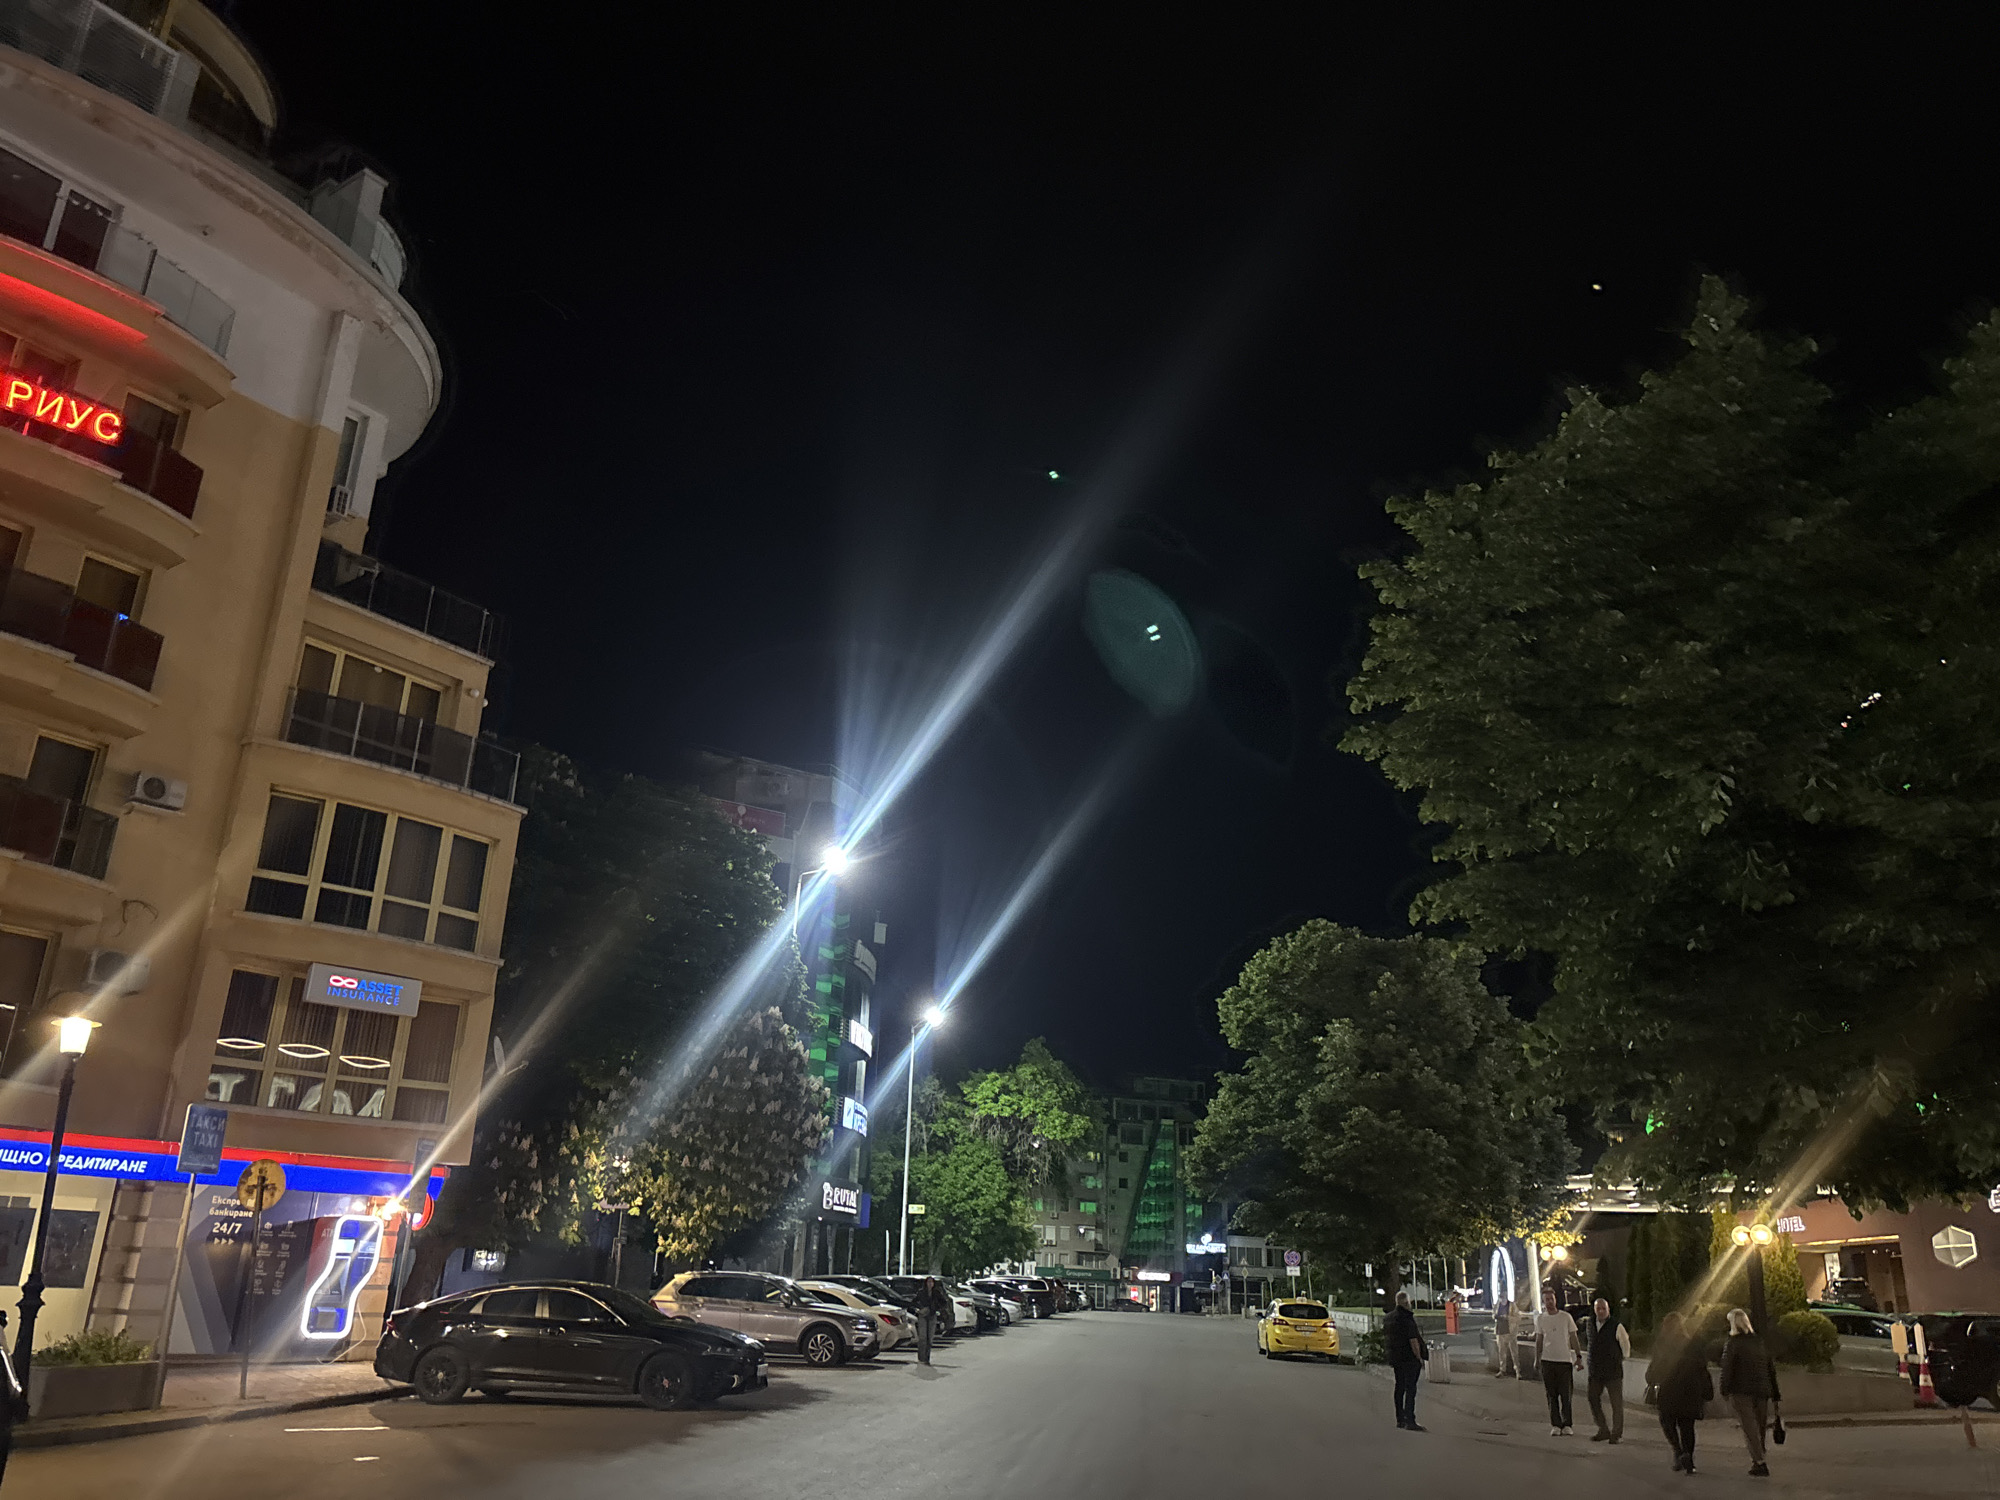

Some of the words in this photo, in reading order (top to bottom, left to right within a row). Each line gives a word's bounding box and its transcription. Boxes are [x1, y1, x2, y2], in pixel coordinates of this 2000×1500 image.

[6, 380, 120, 440] РИУС
[326, 986, 400, 1007] INSURANCE
[357, 979, 404, 997] ASSET
[209, 1207, 254, 1219] банкиране
[212, 1221, 242, 1235] 24/7
[1776, 1215, 1806, 1233] HOTEL
